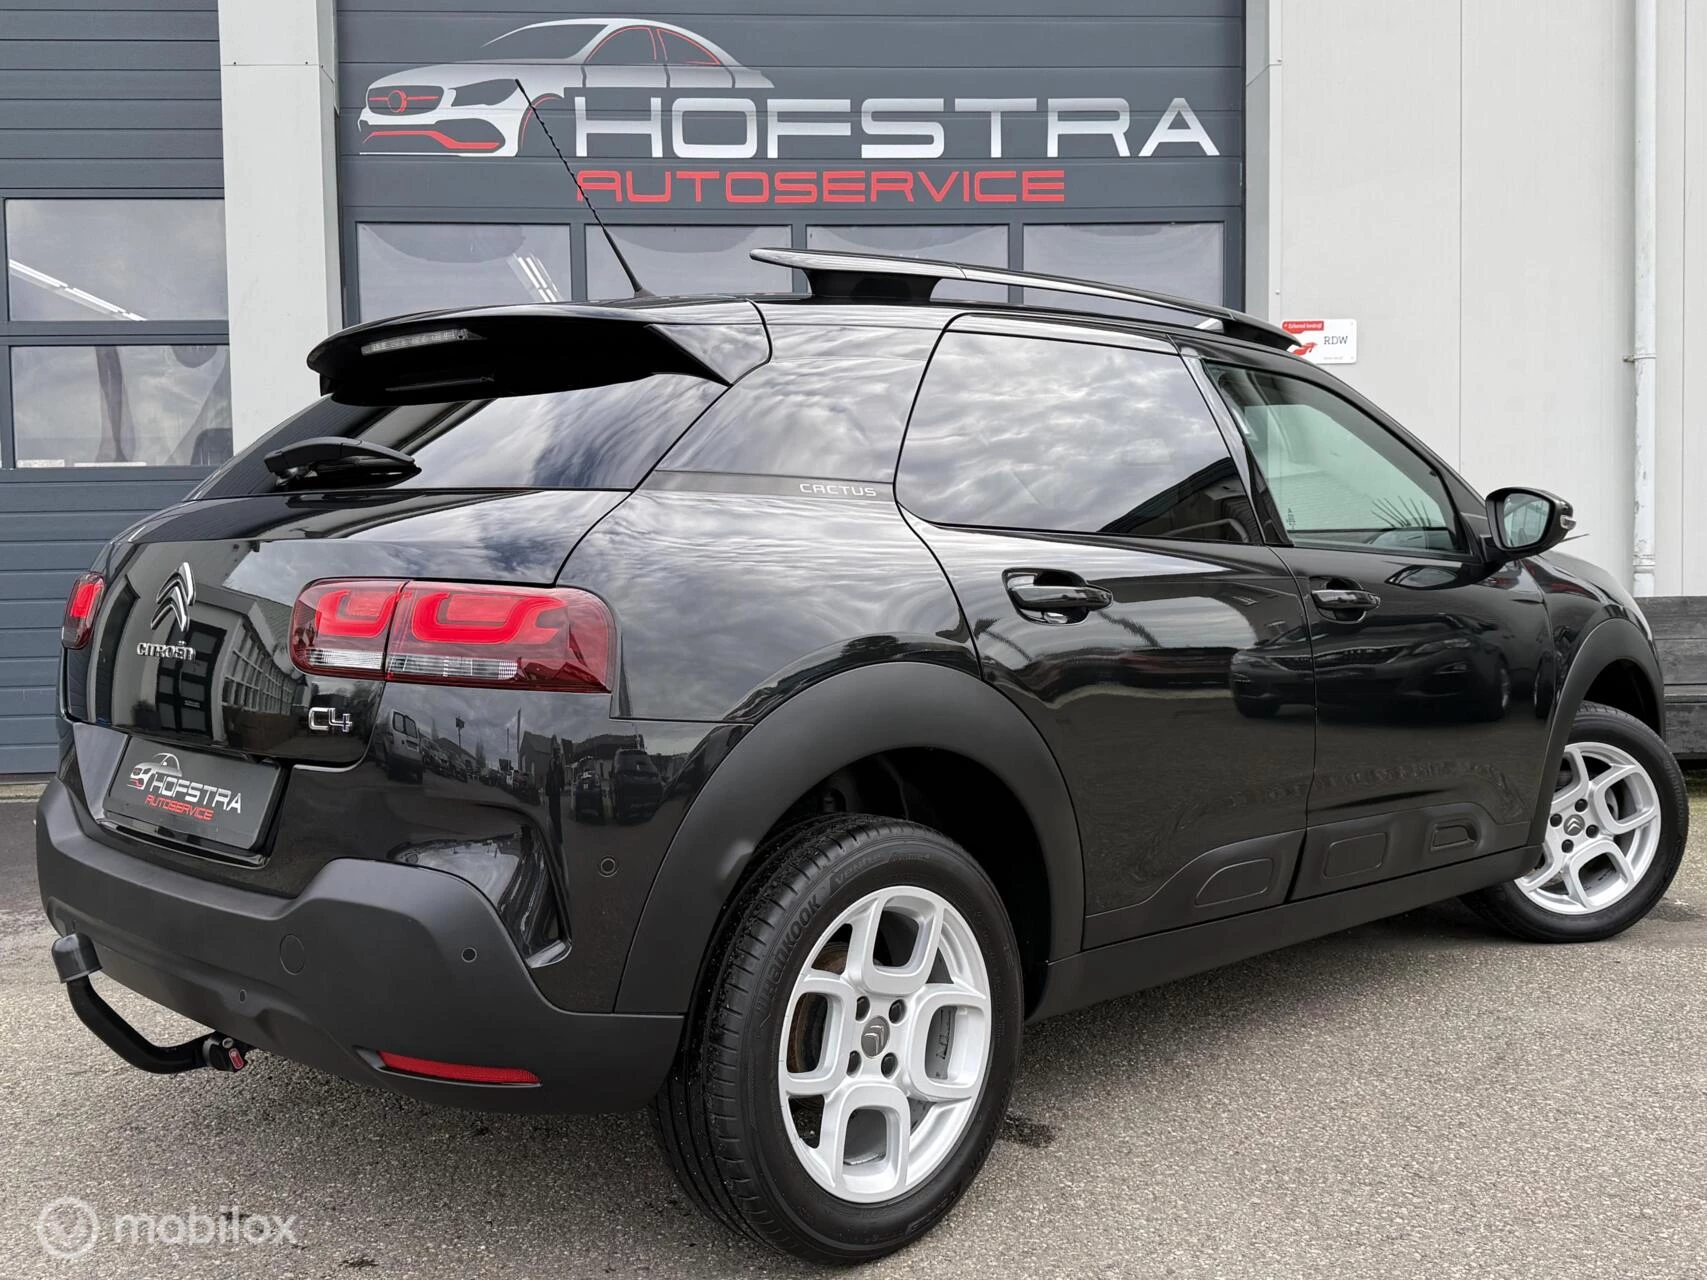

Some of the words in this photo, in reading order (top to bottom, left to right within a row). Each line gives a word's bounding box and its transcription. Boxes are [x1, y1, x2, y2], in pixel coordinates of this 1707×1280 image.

[574, 96, 1221, 158] HOFSTRA
[576, 169, 1065, 203] AUTOSERVICE
[1323, 335, 1348, 345] RDW
[799, 483, 877, 497] CACTUS
[308, 707, 352, 733] C4
[149, 773, 241, 814] HOFSTRA
[144, 794, 215, 821] AUTOSERVICE
